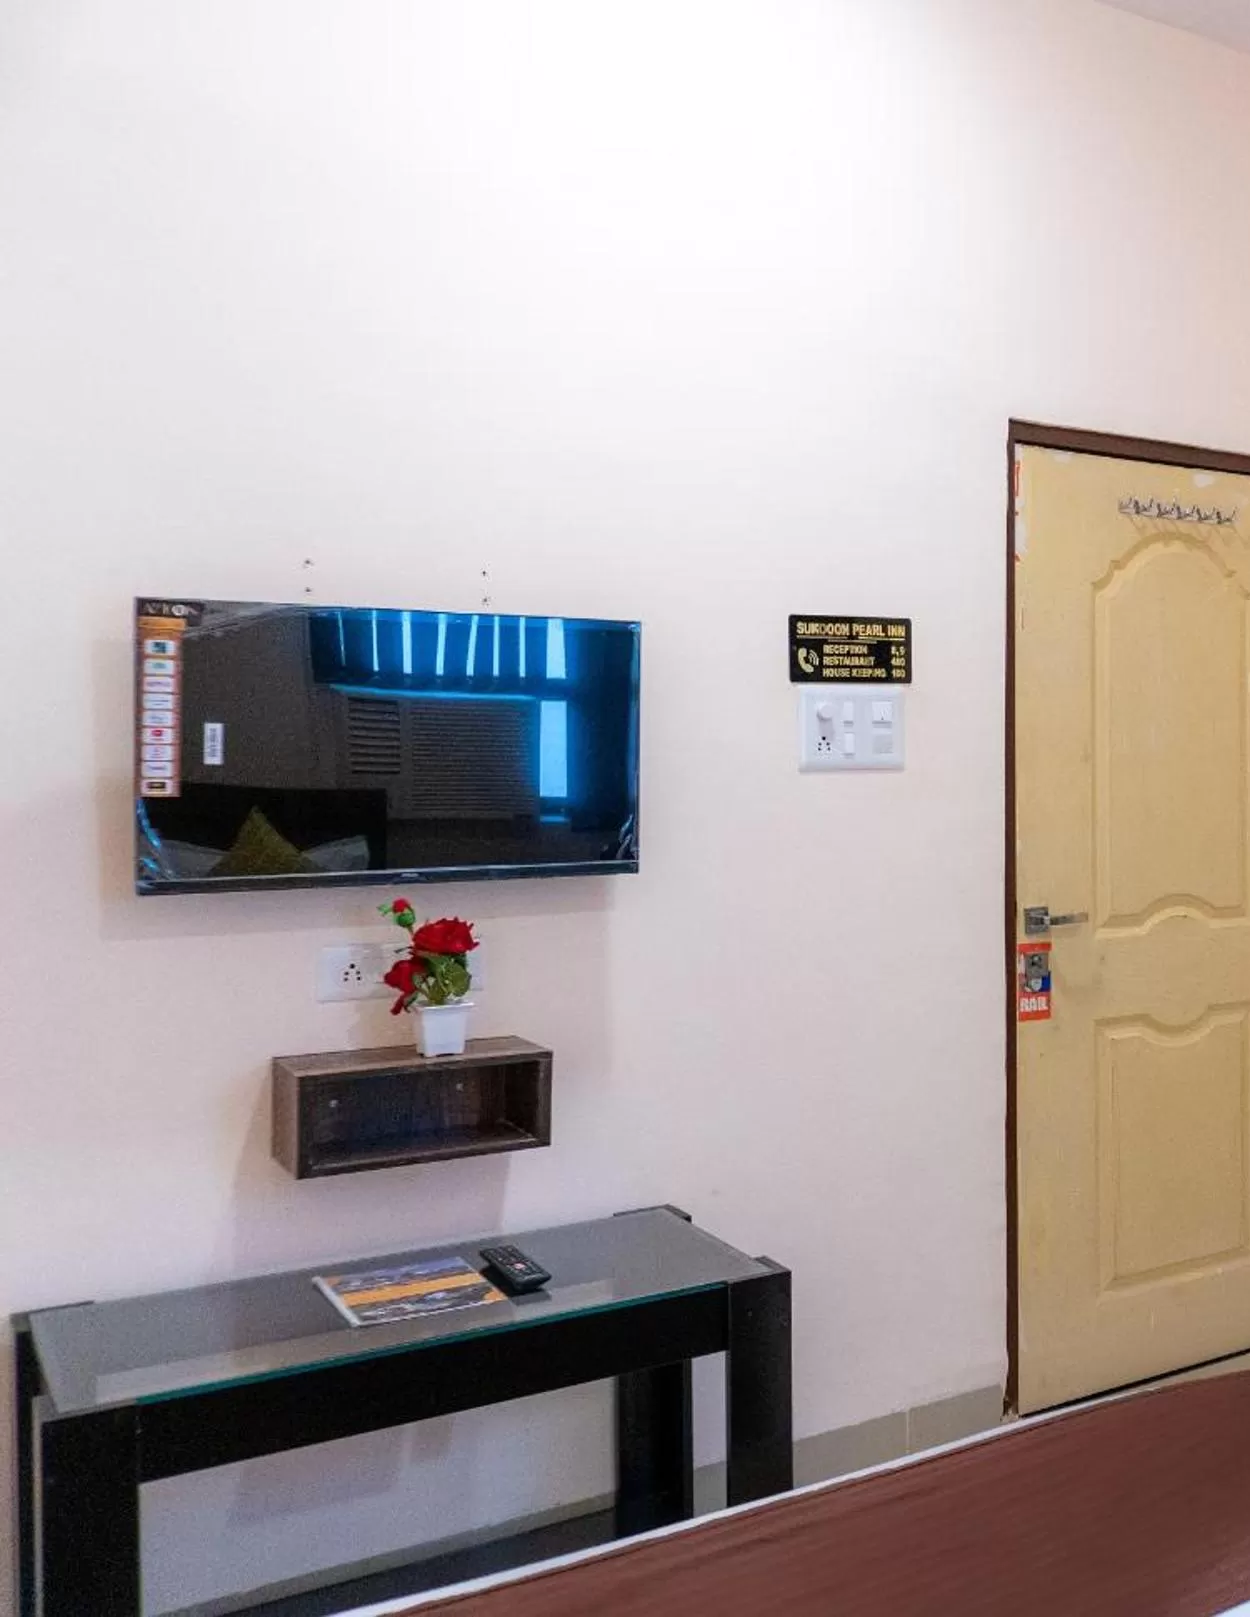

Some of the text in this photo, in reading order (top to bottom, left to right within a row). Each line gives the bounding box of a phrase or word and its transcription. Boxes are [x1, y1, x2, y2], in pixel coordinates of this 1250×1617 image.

[852, 623, 885, 636] PEARL
[887, 624, 906, 637] INN
[822, 644, 868, 654] RECEPTION
[822, 656, 876, 666] RESTAURANT
[822, 667, 850, 678] HOUSE
[851, 668, 887, 678] KEEPING
